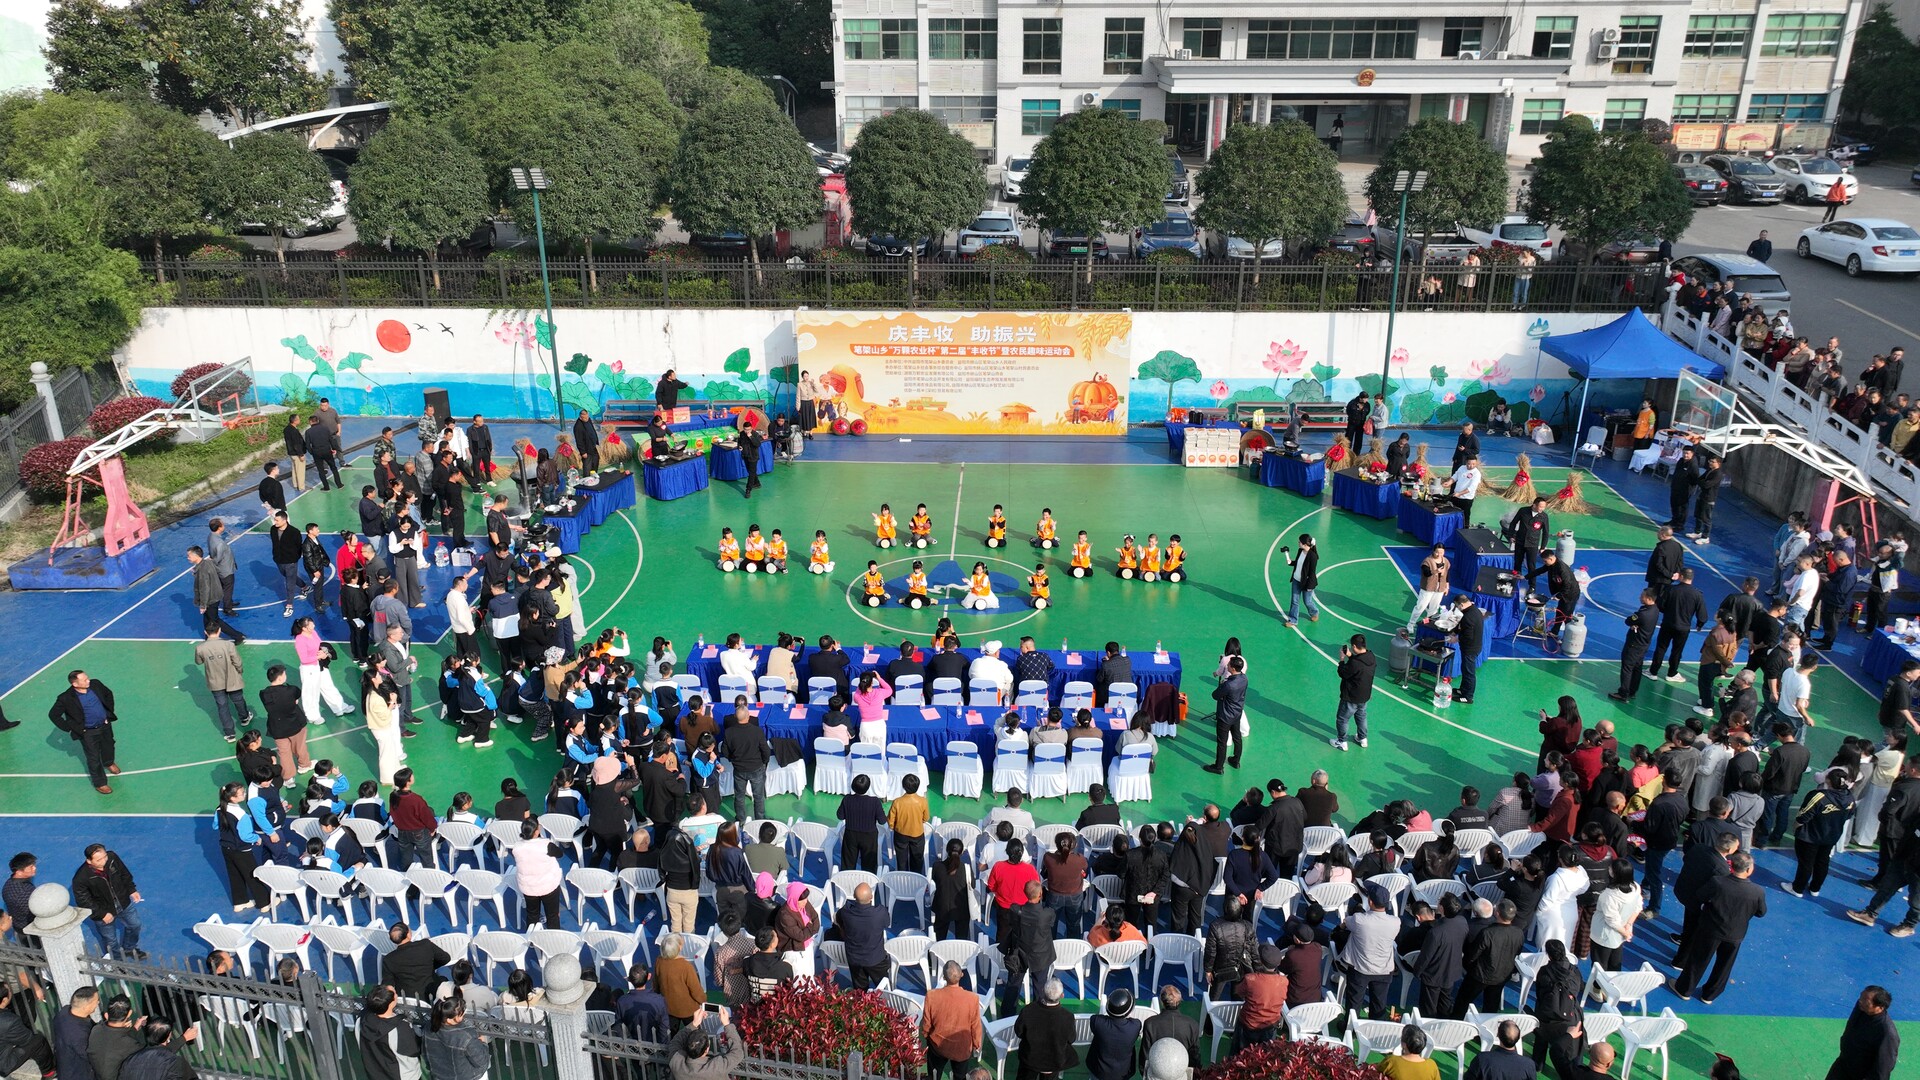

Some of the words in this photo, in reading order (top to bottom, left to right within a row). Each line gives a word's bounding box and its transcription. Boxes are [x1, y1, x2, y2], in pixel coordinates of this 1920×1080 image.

[888, 325, 954, 343] 庆丰收
[970, 325, 1037, 343] 助振兴
